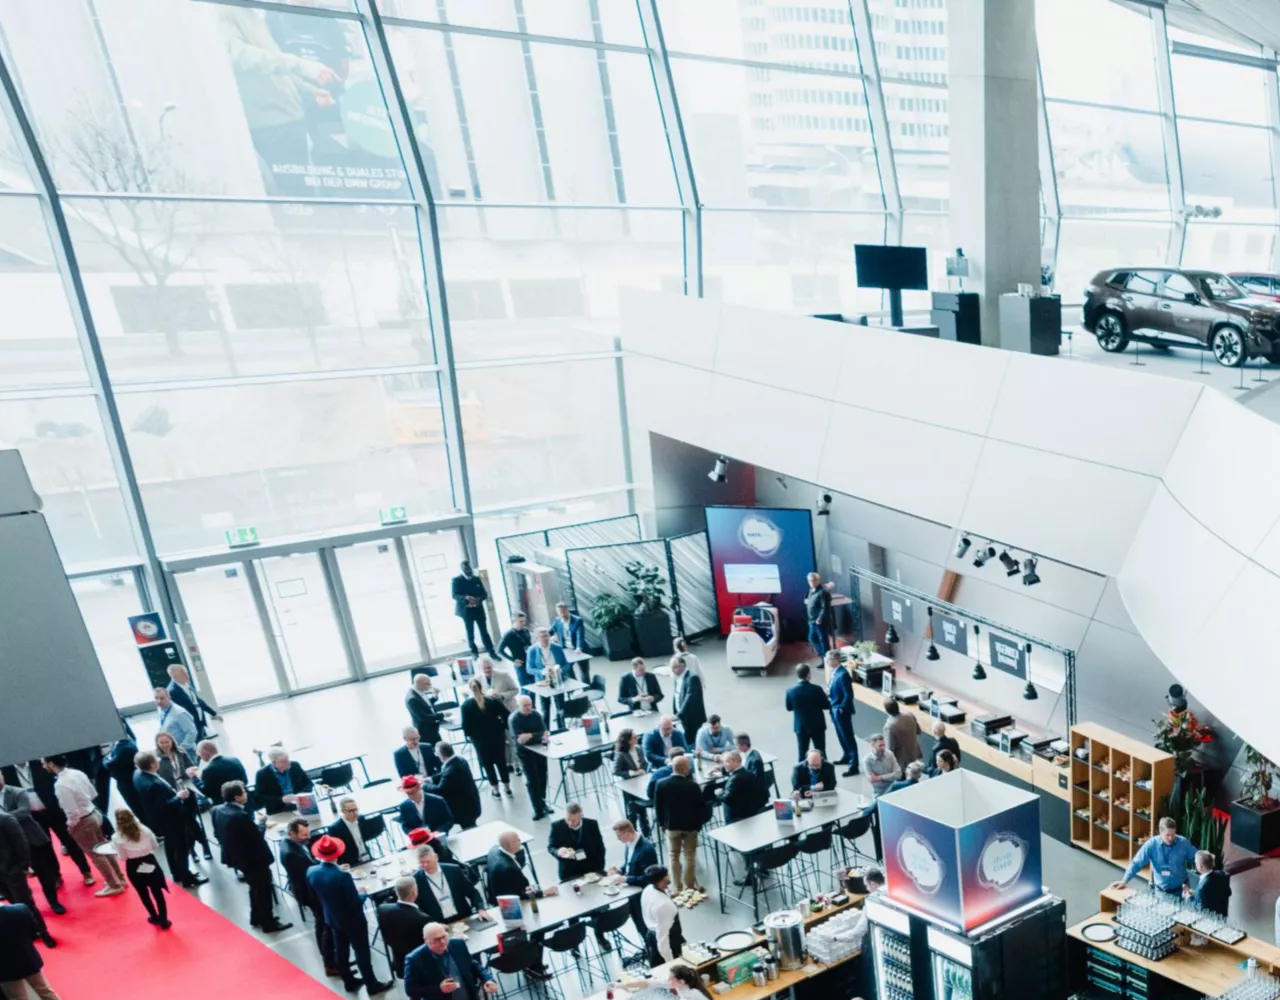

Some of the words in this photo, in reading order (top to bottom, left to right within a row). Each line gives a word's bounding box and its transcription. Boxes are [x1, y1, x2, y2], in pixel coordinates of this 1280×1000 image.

[385, 169, 406, 179] STU
[345, 178, 367, 189] BMW
[369, 179, 402, 190] GROUP
